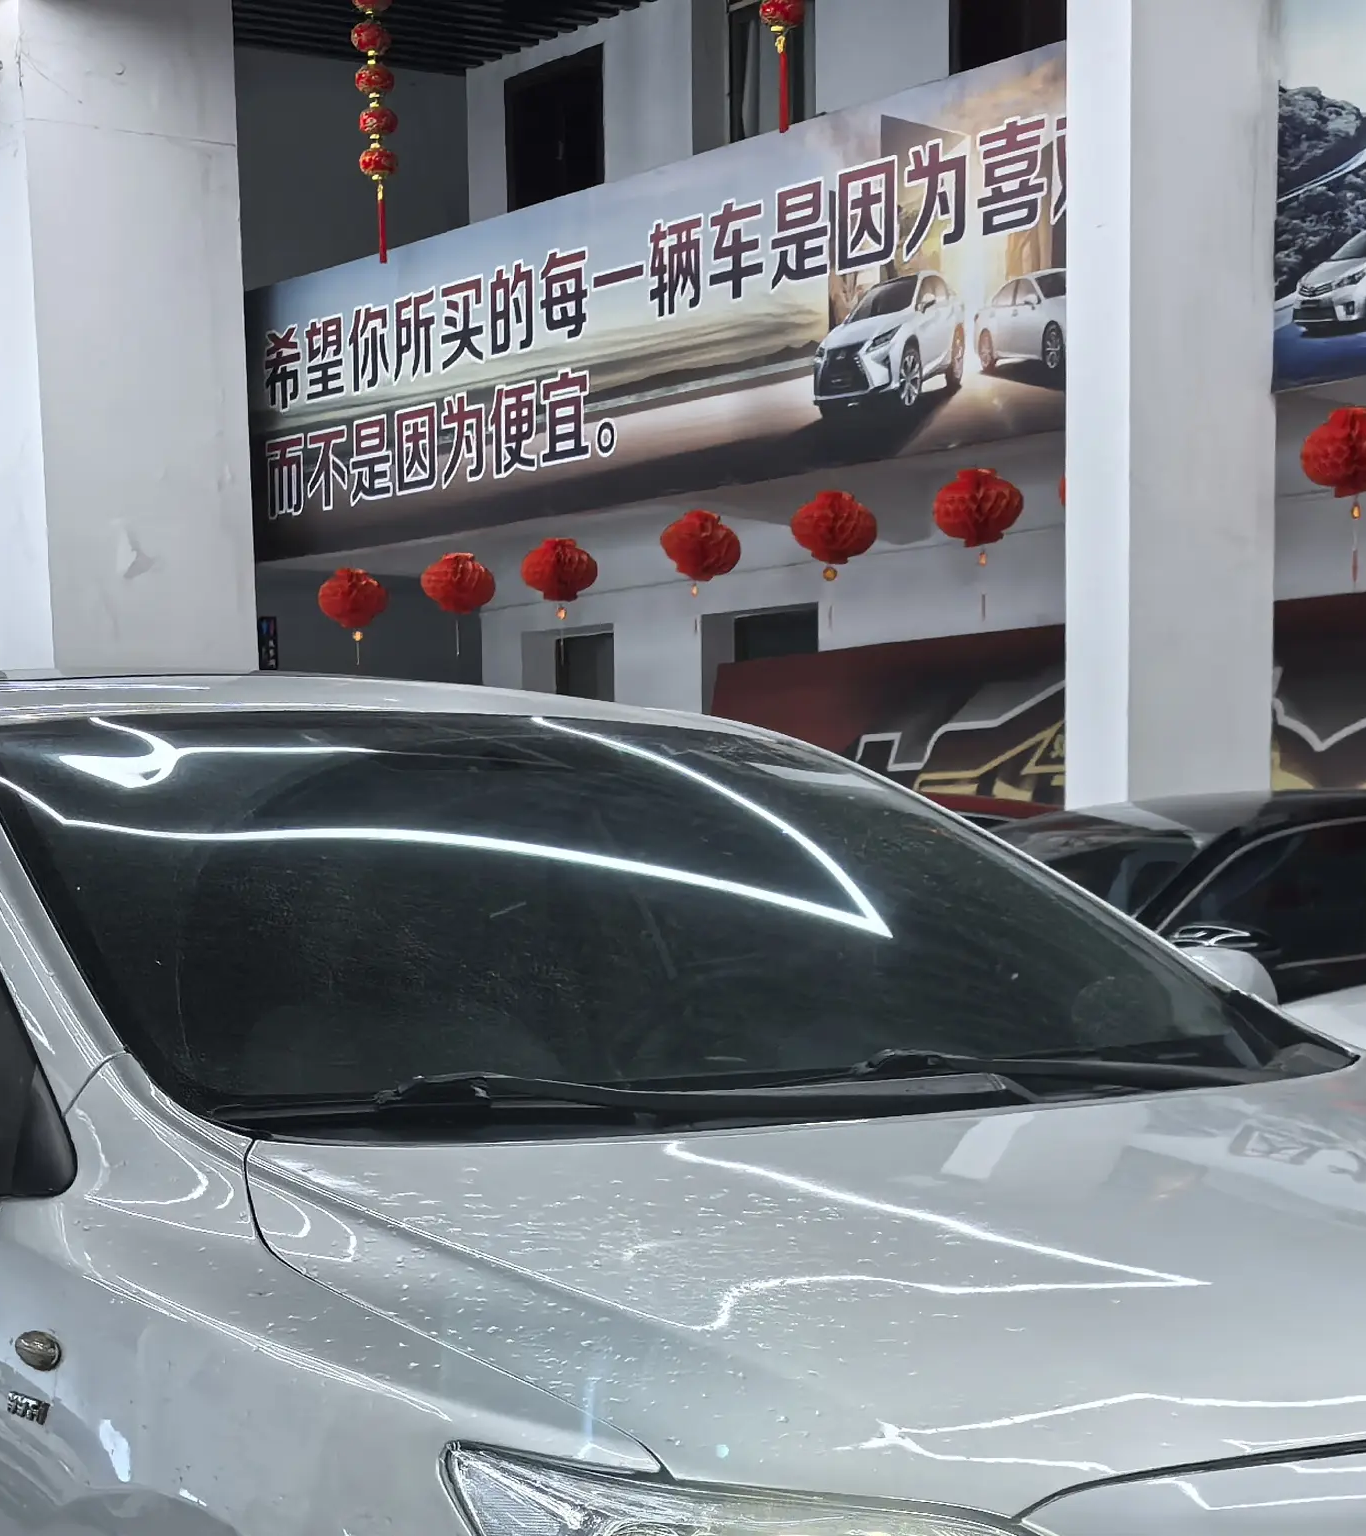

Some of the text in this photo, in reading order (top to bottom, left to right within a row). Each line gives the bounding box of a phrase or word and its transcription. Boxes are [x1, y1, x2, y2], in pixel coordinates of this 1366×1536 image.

[263, 114, 1066, 410] 希望你所买的每一辆车是因为喜
[265, 369, 617, 520] 而不是因为便宜。
